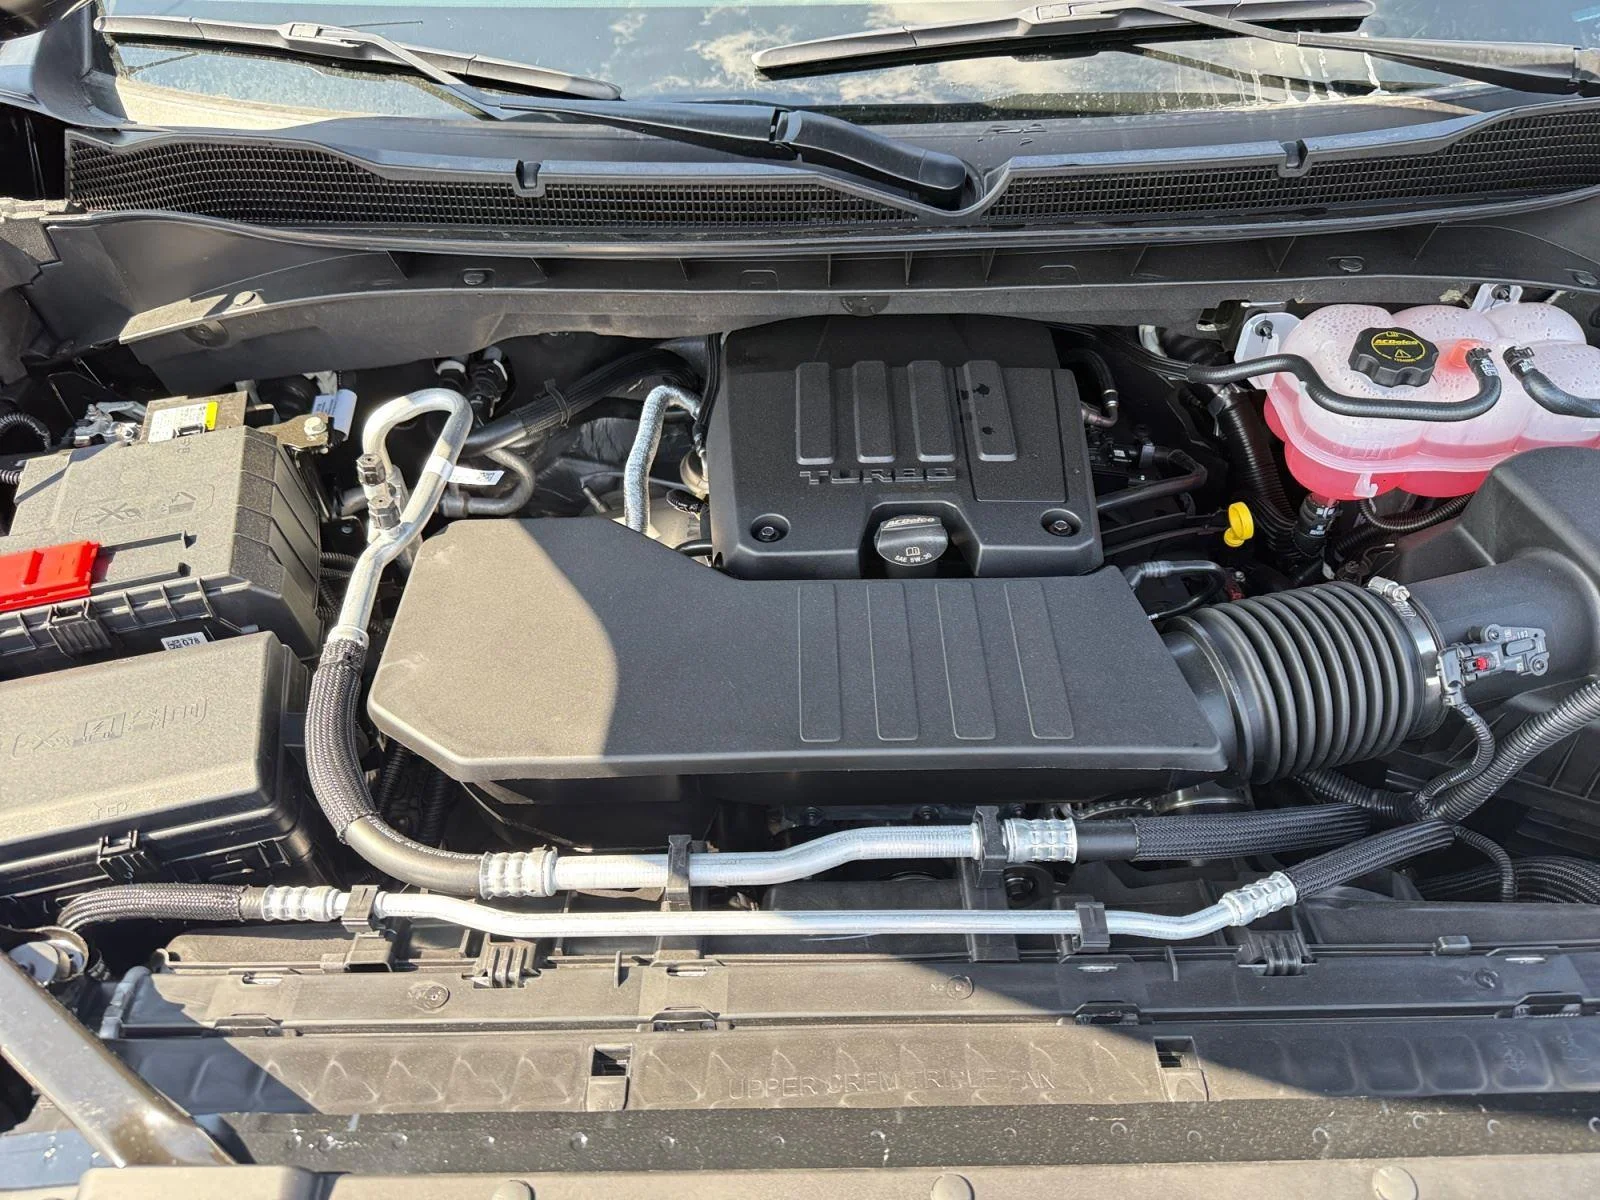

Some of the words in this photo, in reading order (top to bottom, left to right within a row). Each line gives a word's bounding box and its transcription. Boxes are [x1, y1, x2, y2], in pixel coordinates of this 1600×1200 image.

[799, 467, 957, 486] TURBO
[884, 517, 935, 529] ACDelco
[728, 1076, 818, 1100] UPPER
